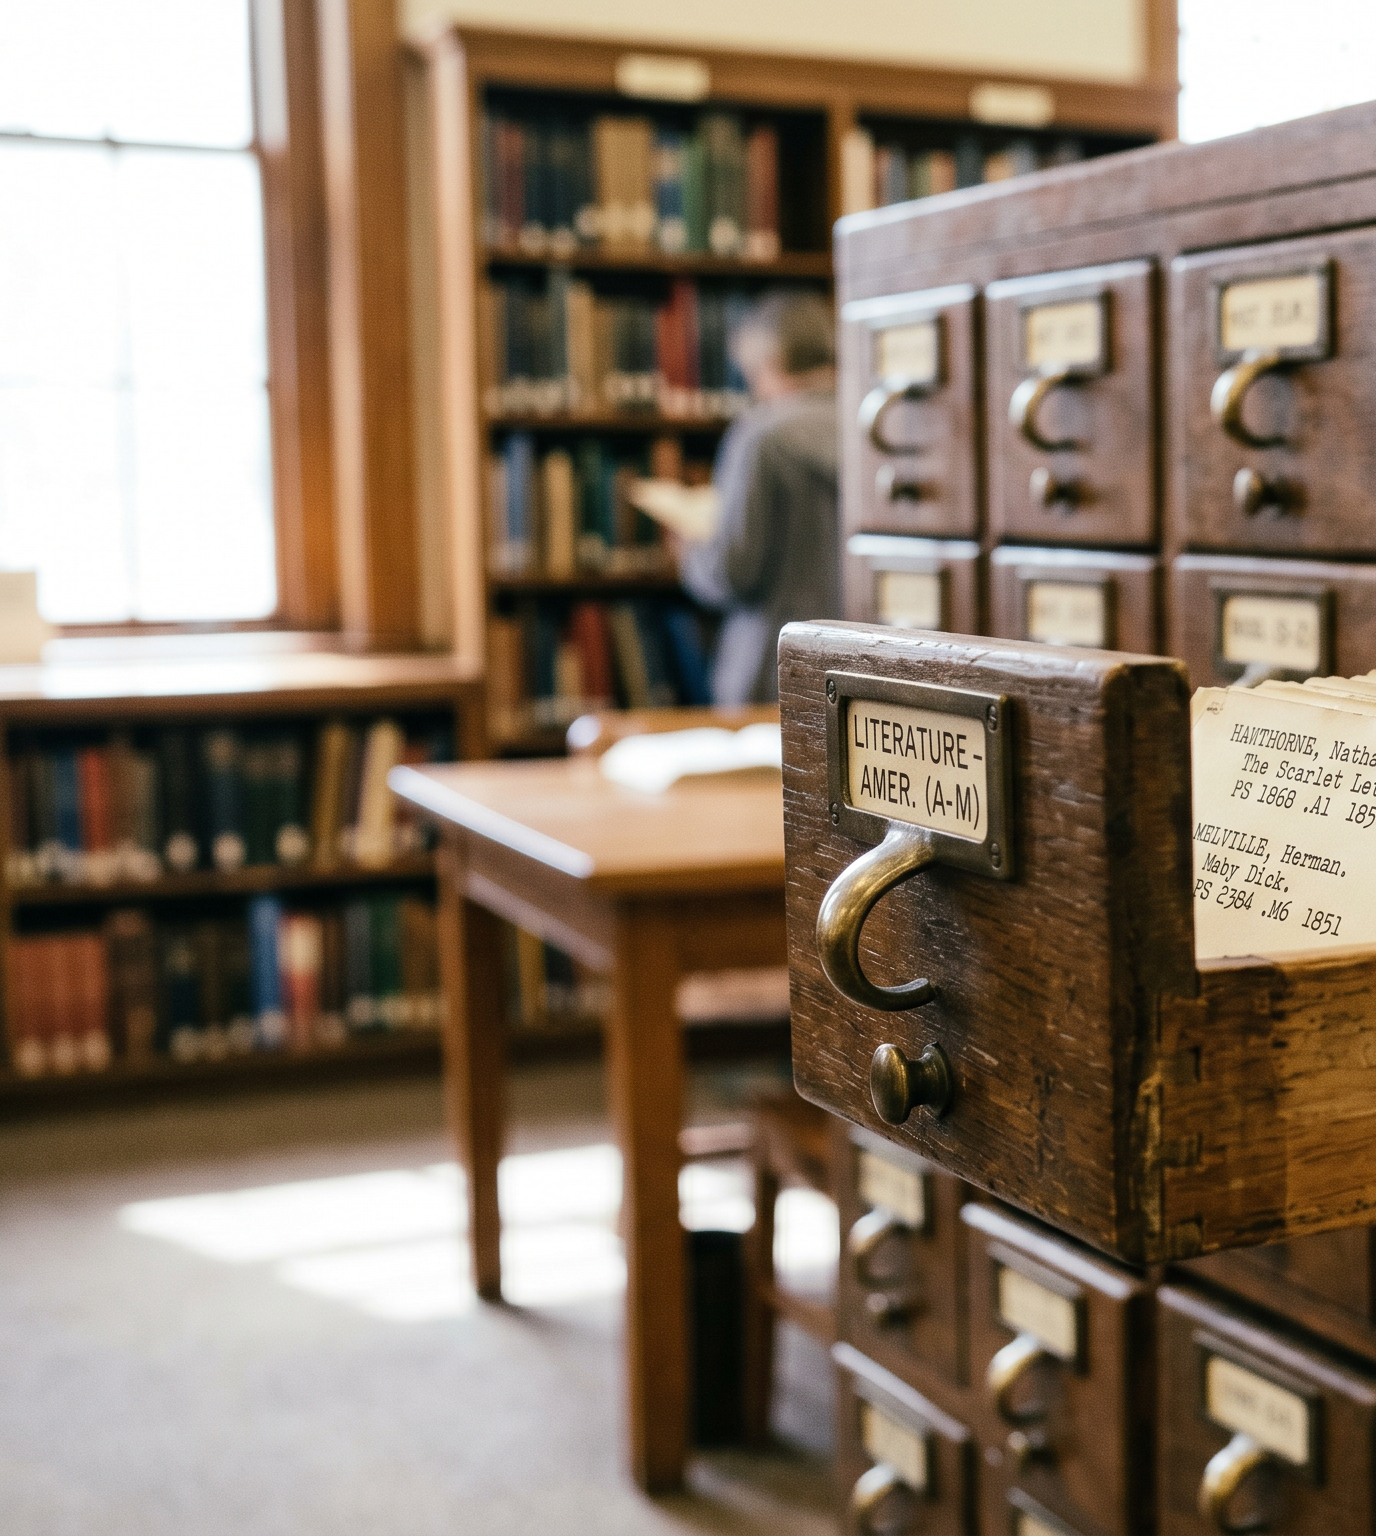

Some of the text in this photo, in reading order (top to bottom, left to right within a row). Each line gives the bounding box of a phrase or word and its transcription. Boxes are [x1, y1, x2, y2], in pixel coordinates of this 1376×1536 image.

[1231, 779, 1253, 800] PS
[1257, 784, 1297, 809] 1868
[1241, 752, 1269, 775] The
[1275, 760, 1344, 790] Scarlet
[860, 764, 980, 831] AMER. (A-M)
[1192, 822, 1346, 877] MELVILLE, Herman.
[1244, 864, 1289, 893] Dick.
[1193, 879, 1343, 936] PS 2384 .M6 1851
